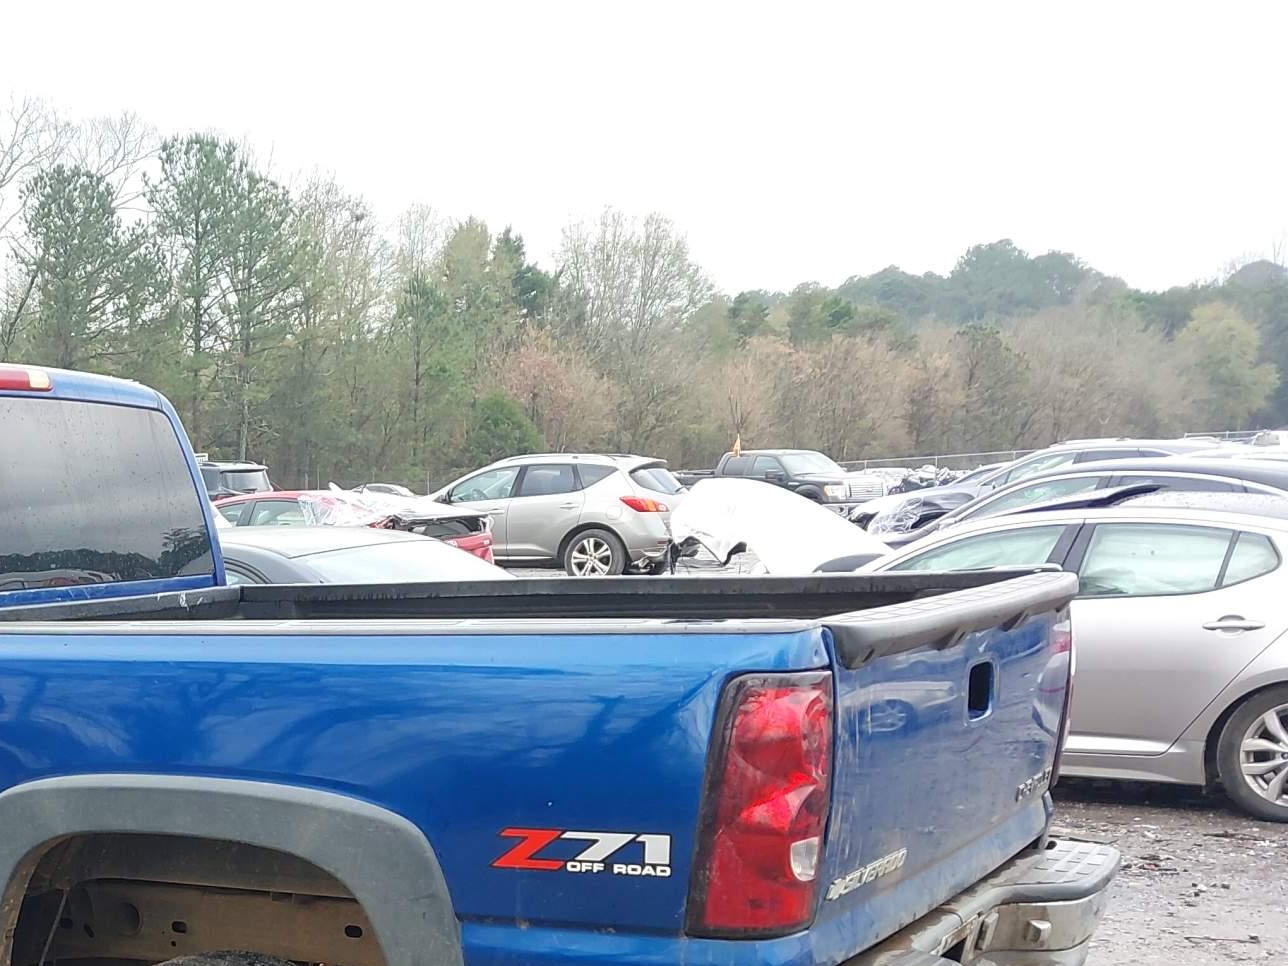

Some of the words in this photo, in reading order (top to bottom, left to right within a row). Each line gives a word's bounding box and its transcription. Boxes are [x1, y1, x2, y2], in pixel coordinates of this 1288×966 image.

[491, 828, 671, 870] Z71
[566, 861, 605, 873] OFF
[613, 864, 672, 877] ROAD
